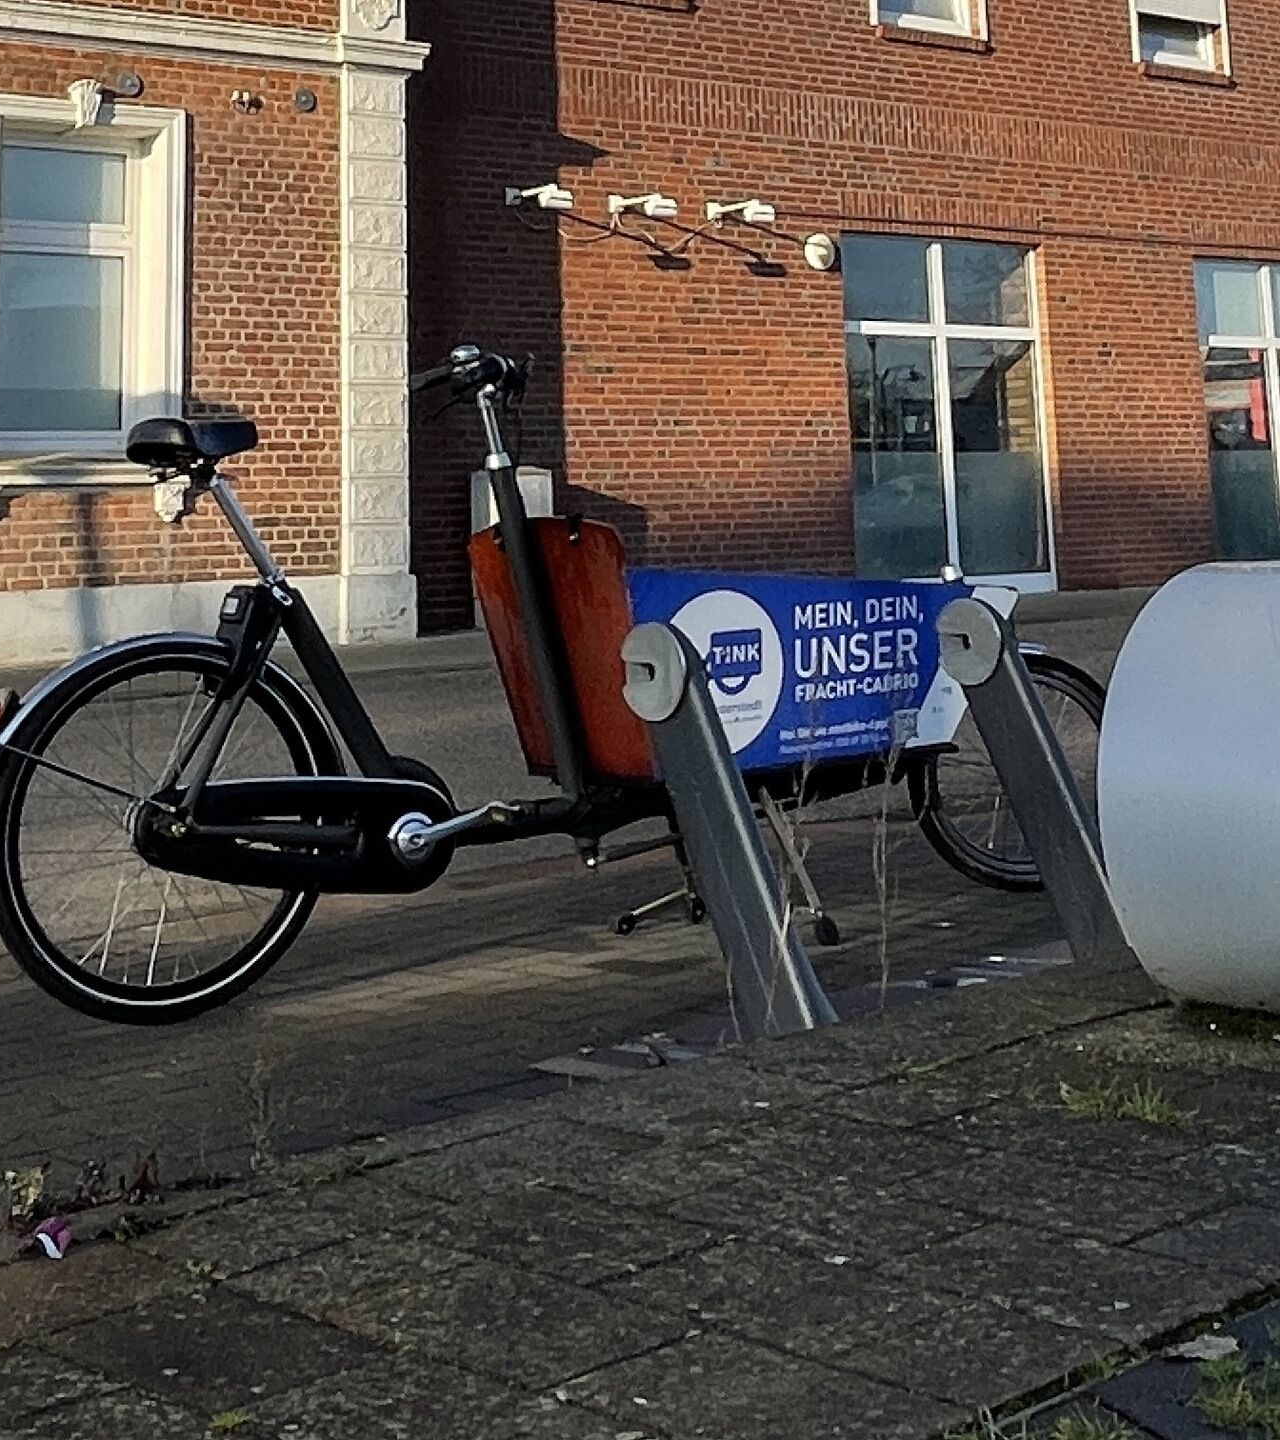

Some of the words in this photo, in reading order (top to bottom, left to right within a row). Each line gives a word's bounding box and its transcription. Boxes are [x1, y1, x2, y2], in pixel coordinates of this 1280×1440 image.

[794, 601, 859, 630] MEIN,
[865, 595, 924, 623] DEIN,
[794, 628, 919, 678] UNSER
